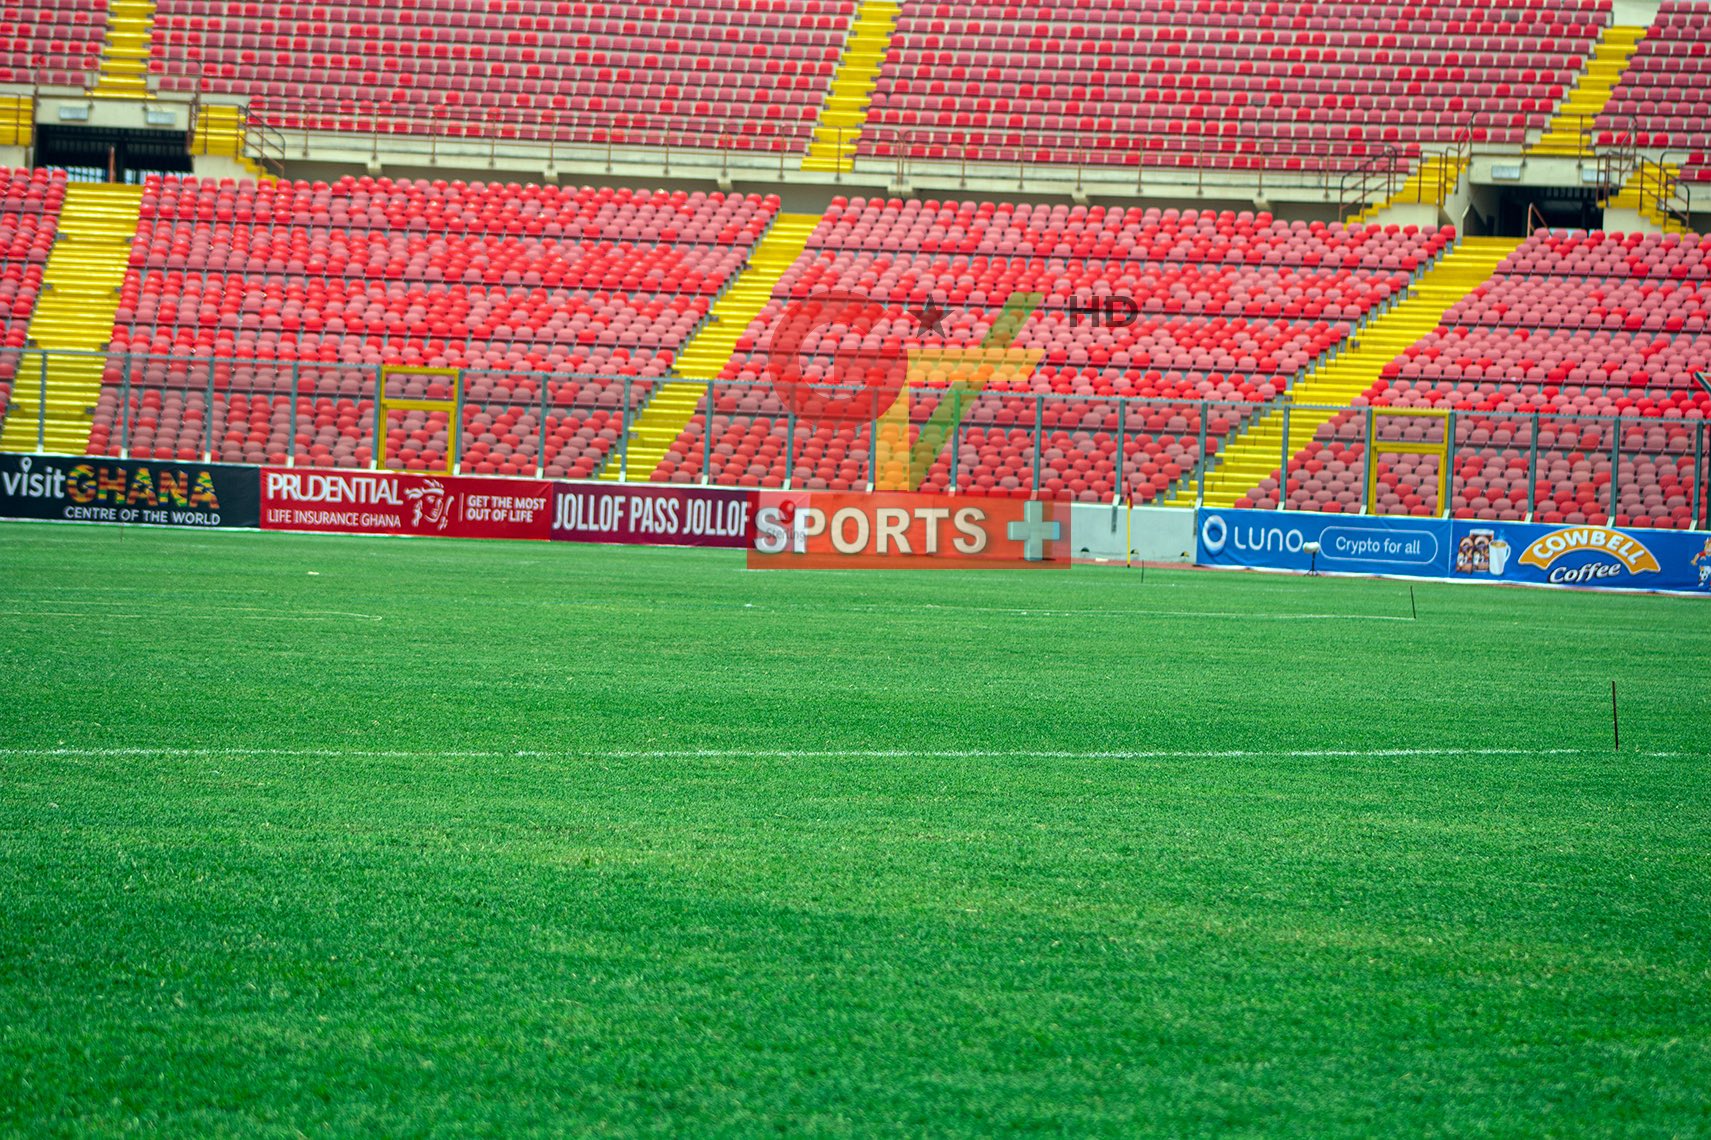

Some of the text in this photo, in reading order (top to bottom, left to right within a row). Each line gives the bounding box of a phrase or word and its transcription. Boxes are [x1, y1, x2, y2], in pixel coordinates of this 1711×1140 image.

[2, 457, 66, 498] visit
[66, 464, 220, 509] GHANA
[267, 473, 403, 505] PRUDENTIAL
[467, 495, 547, 510] GET THE MOST
[64, 506, 221, 525] CENTRE OF THE WORLD
[267, 508, 401, 528] LIFE INSURANCE GHANA
[466, 508, 534, 523] OUT OF LIFE
[552, 493, 752, 537] JOLLOF PASS JOLLOF
[1234, 526, 1304, 552] LUNO
[1335, 536, 1421, 555] Crypto for all
[1532, 529, 1644, 566] COWBELL
[1549, 562, 1622, 583] Coffee
